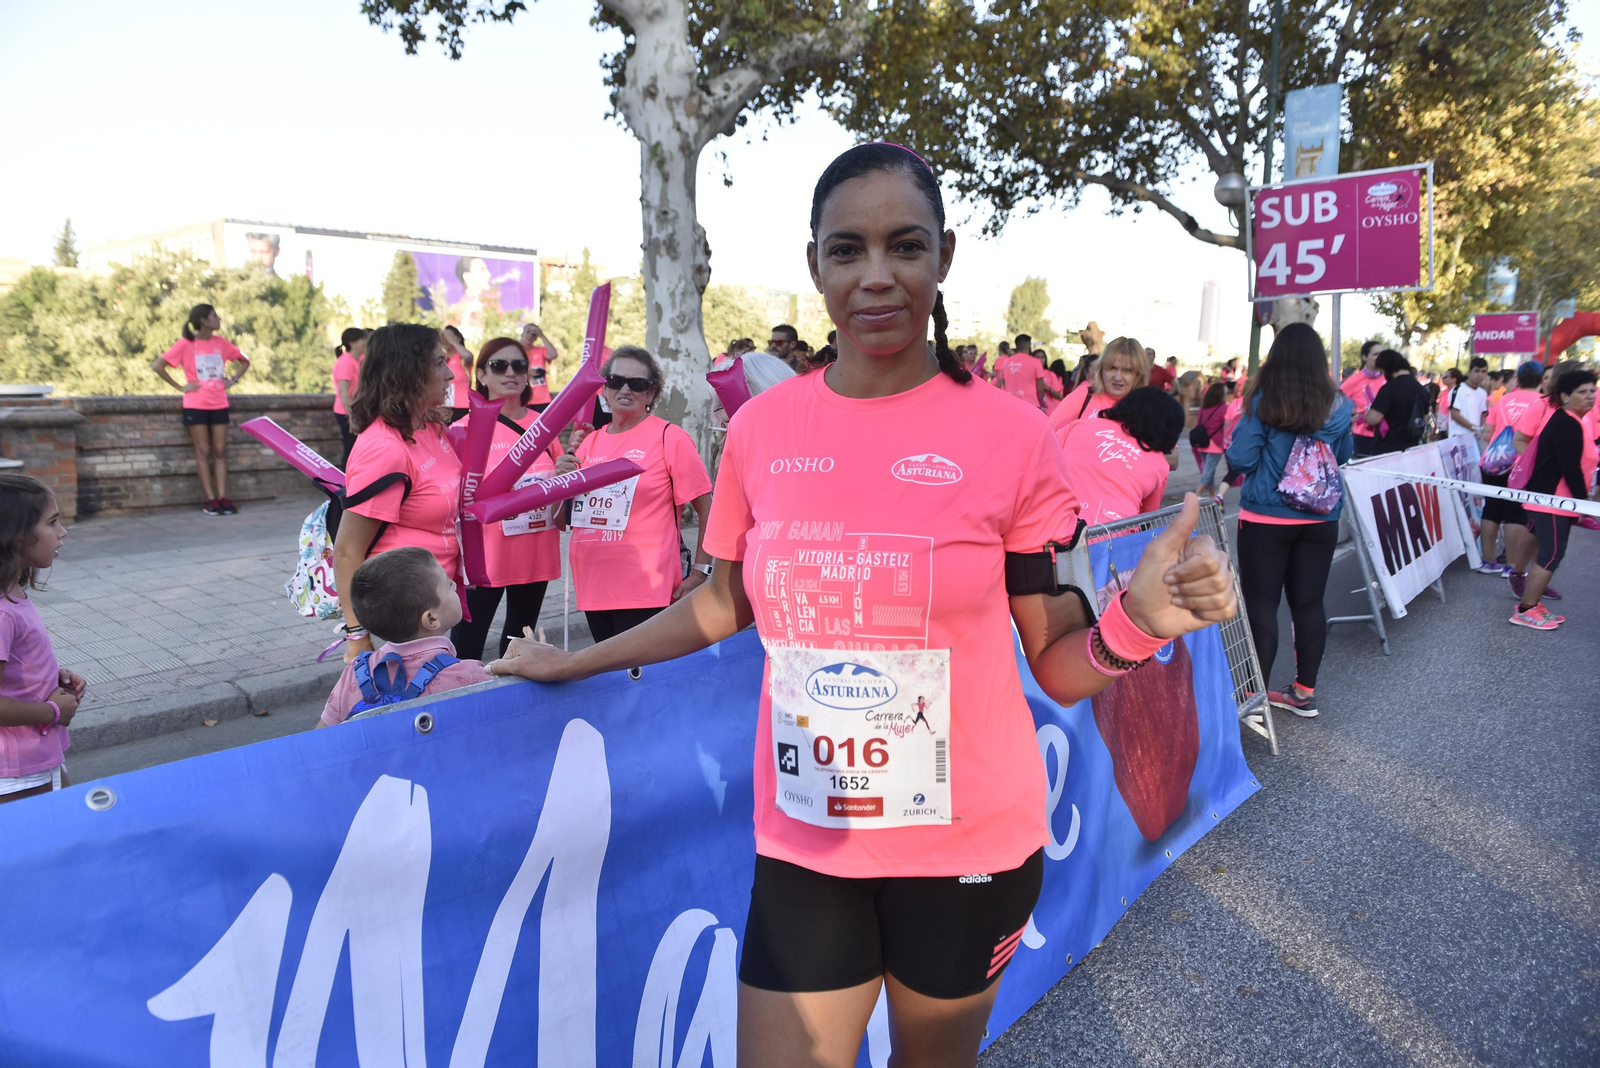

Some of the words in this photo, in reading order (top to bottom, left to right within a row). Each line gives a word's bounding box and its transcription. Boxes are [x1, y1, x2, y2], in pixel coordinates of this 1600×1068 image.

[1260, 190, 1339, 229] SUB
[1361, 211, 1418, 229] OYSHO
[1258, 233, 1346, 286] 45'
[1474, 330, 1514, 340] ANDAR
[509, 419, 550, 467] Ladival
[1095, 429, 1140, 456] Carrera
[770, 456, 835, 475] OYSHO
[896, 463, 957, 480] ASTURIANA
[538, 470, 587, 495] Ladival
[589, 496, 613, 508] 016
[787, 521, 845, 542] GANAN
[1370, 472, 1444, 577] MRW
[601, 530, 623, 541] 2019
[798, 550, 844, 564] VITORIA
[856, 552, 909, 567] GASTEIZ
[820, 566, 871, 580] MADRID
[798, 619, 815, 632] CIA
[824, 616, 851, 636] LAS
[811, 678, 890, 699] ASTURIANA
[865, 710, 903, 722] Carrera
[888, 720, 917, 738] Mujer
[813, 735, 889, 768] 016
[829, 775, 870, 790] 1652
[784, 790, 813, 808] OYSHO
[842, 803, 877, 812] Santander
[903, 808, 937, 817] ZURICH
[959, 873, 993, 884] adidas
